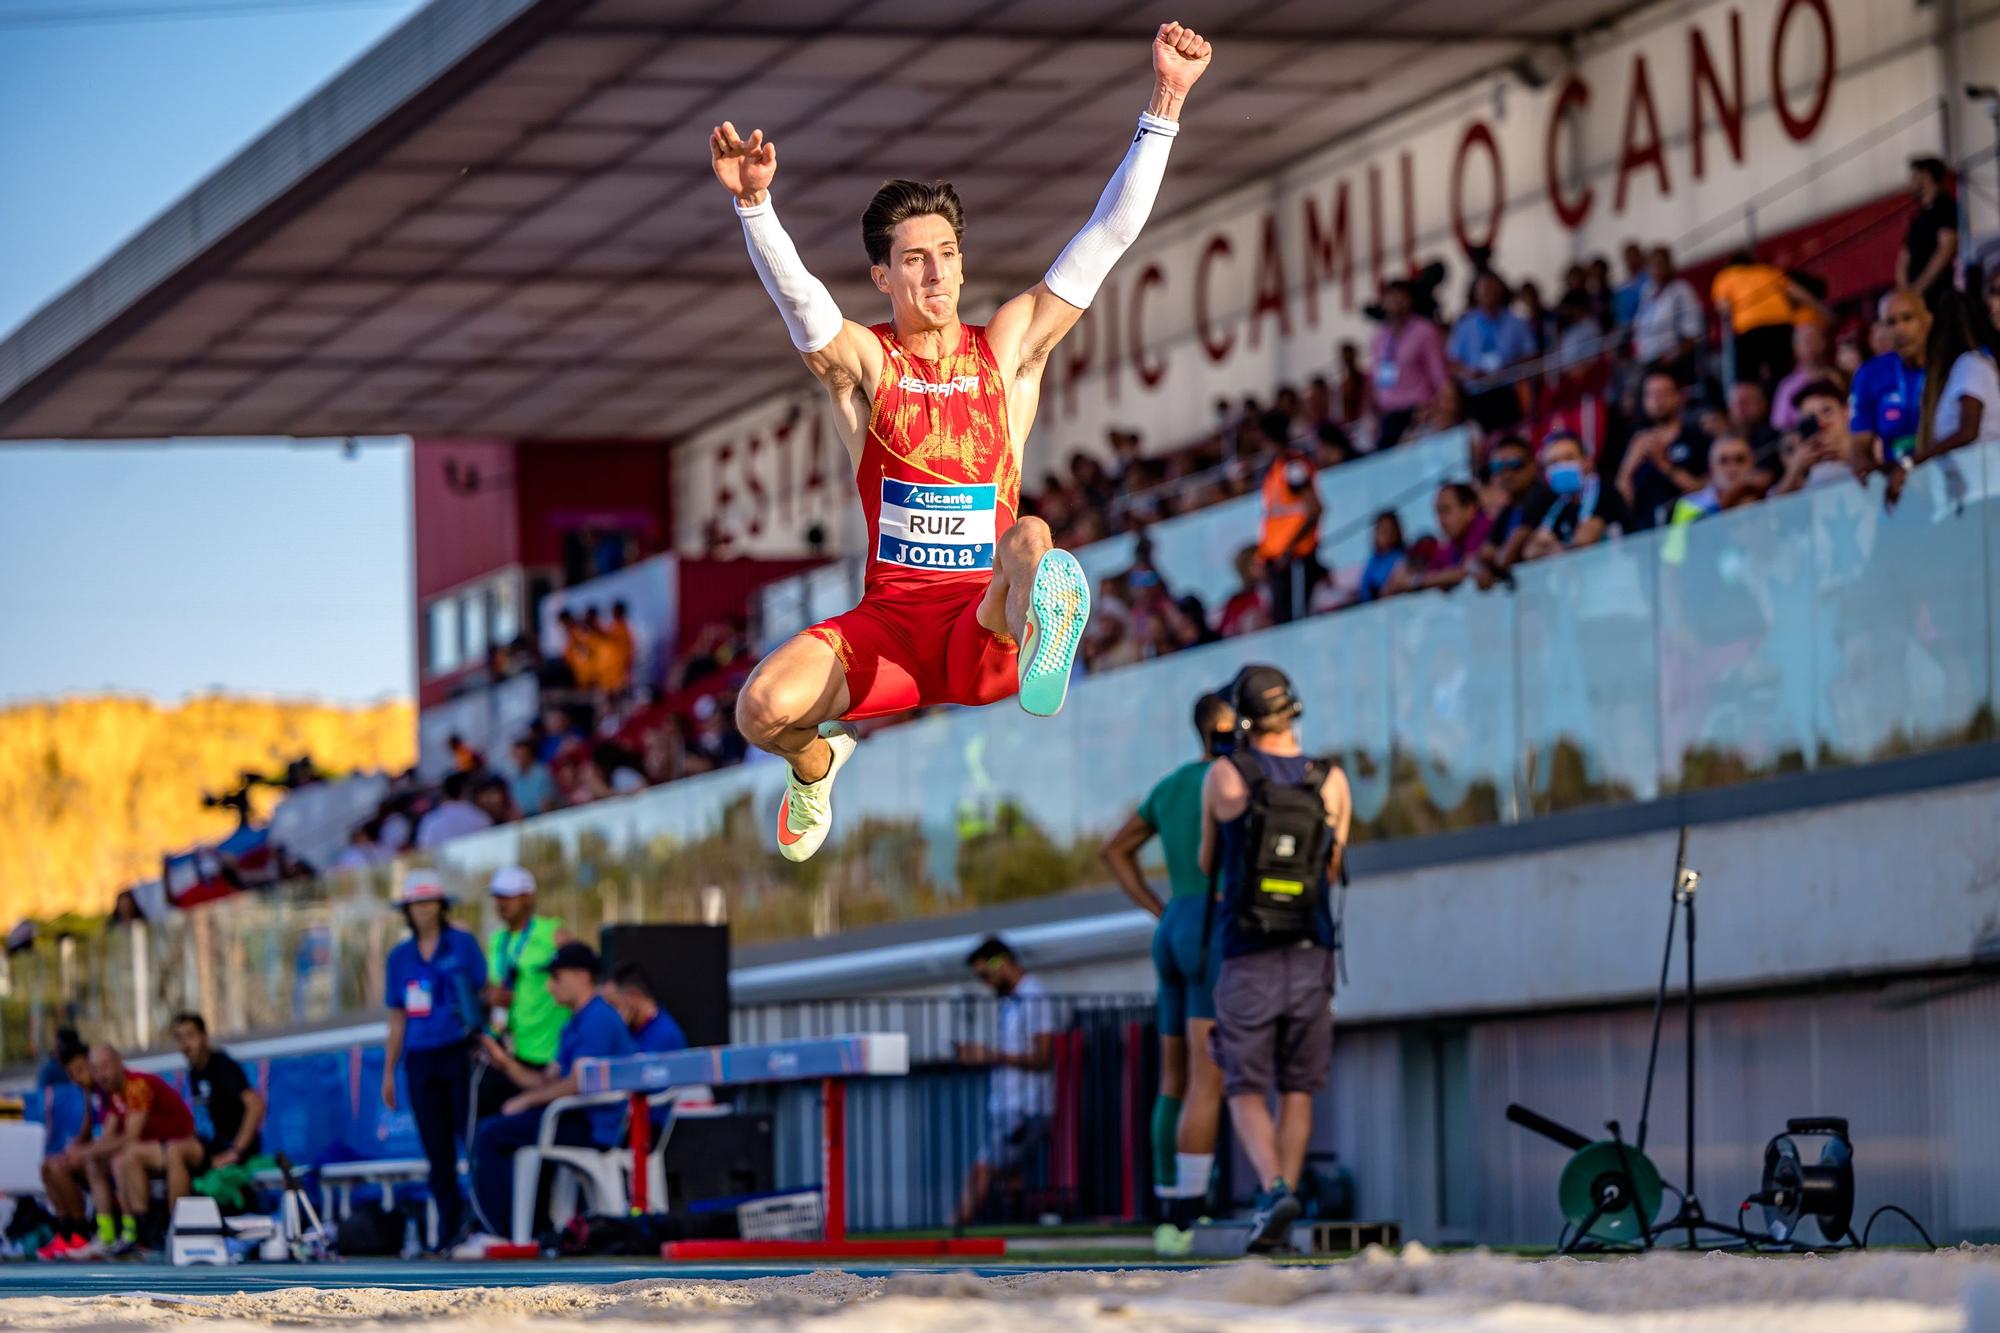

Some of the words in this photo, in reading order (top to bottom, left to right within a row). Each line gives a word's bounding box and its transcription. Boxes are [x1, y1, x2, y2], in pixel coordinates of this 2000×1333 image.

[1194, 121, 1507, 364] CAMILO
[1545, 0, 1836, 231] CANO
[909, 515, 966, 536] RUIZ
